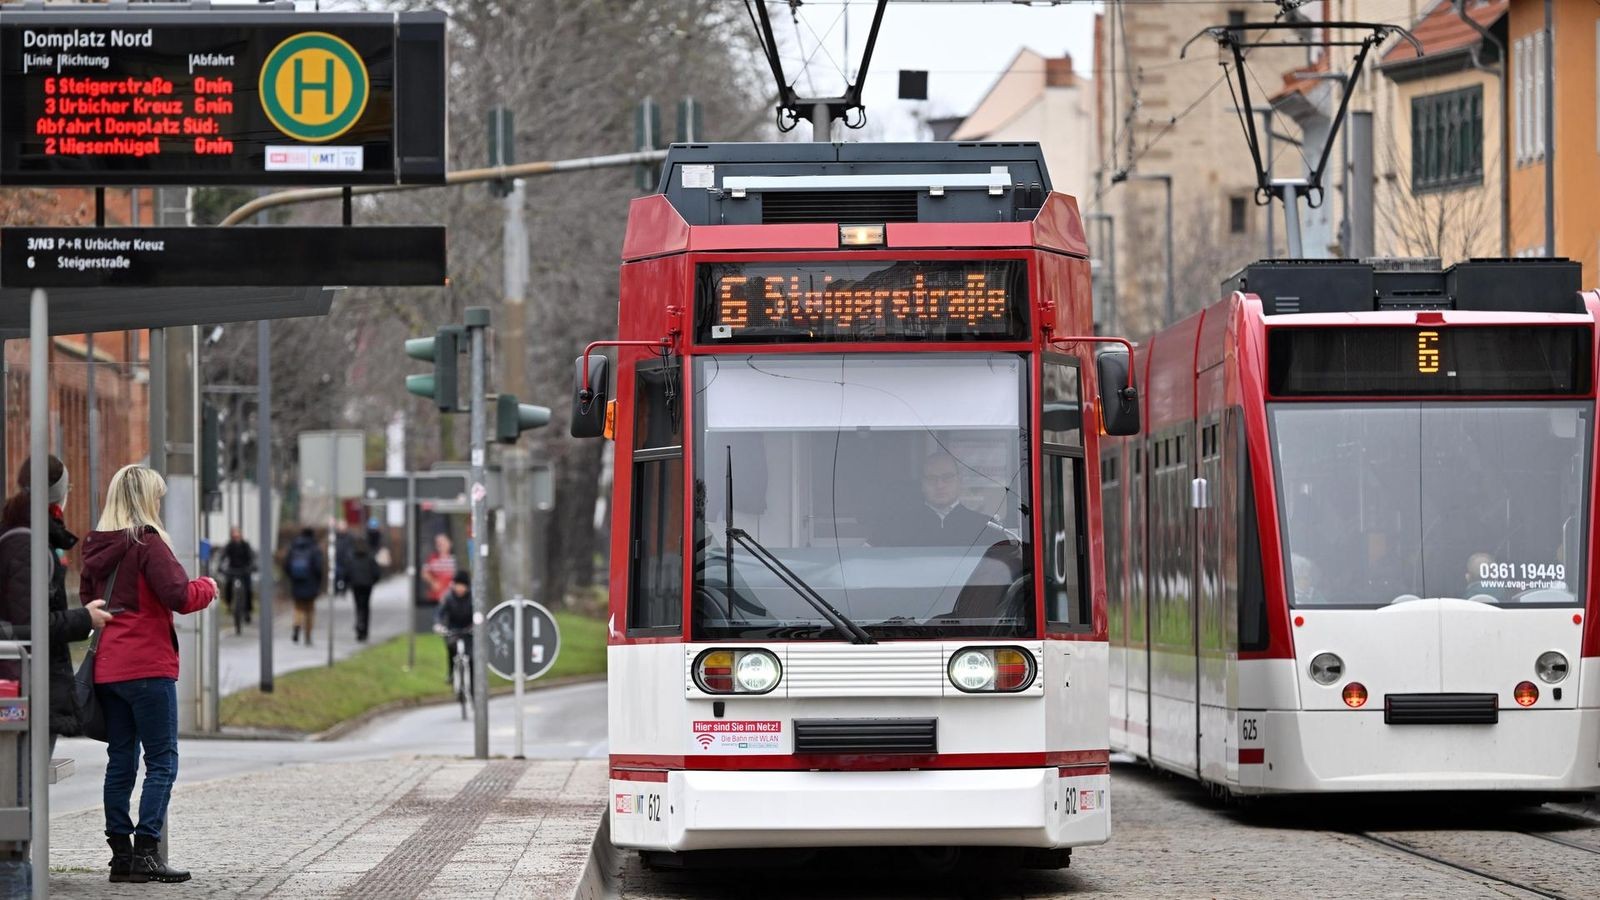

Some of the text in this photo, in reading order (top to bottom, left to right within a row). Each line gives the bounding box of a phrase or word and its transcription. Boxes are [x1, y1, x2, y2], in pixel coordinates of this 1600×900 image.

[24, 29, 152, 51] Domplatz Nord
[27, 54, 235, 69] Linie Richtung Abfahrt
[45, 78, 55, 93] 6
[59, 78, 172, 96] Steigerstraße
[294, 58, 334, 115] H
[45, 98, 55, 114] 3
[59, 98, 129, 114] Urbicher
[133, 98, 182, 114] Kreuz
[37, 118, 100, 134] Abfahrt
[105, 118, 180, 136] Domplatz
[45, 138, 56, 154] 2
[60, 138, 160, 156] Wiesenhügel
[27, 238, 164, 250] 3/N3 P+R Urbicher Kreuz
[26, 256, 130, 271] 6 Steigerstraße
[721, 274, 1005, 327] 6 Steigerstraße
[1418, 331, 1438, 373] 6
[1480, 563, 1565, 579] 0361 19449
[695, 722, 778, 731] Hier sind Sie im Netz!
[1243, 719, 1257, 740] 625
[648, 793, 661, 821] 612
[1066, 787, 1076, 815] 612
